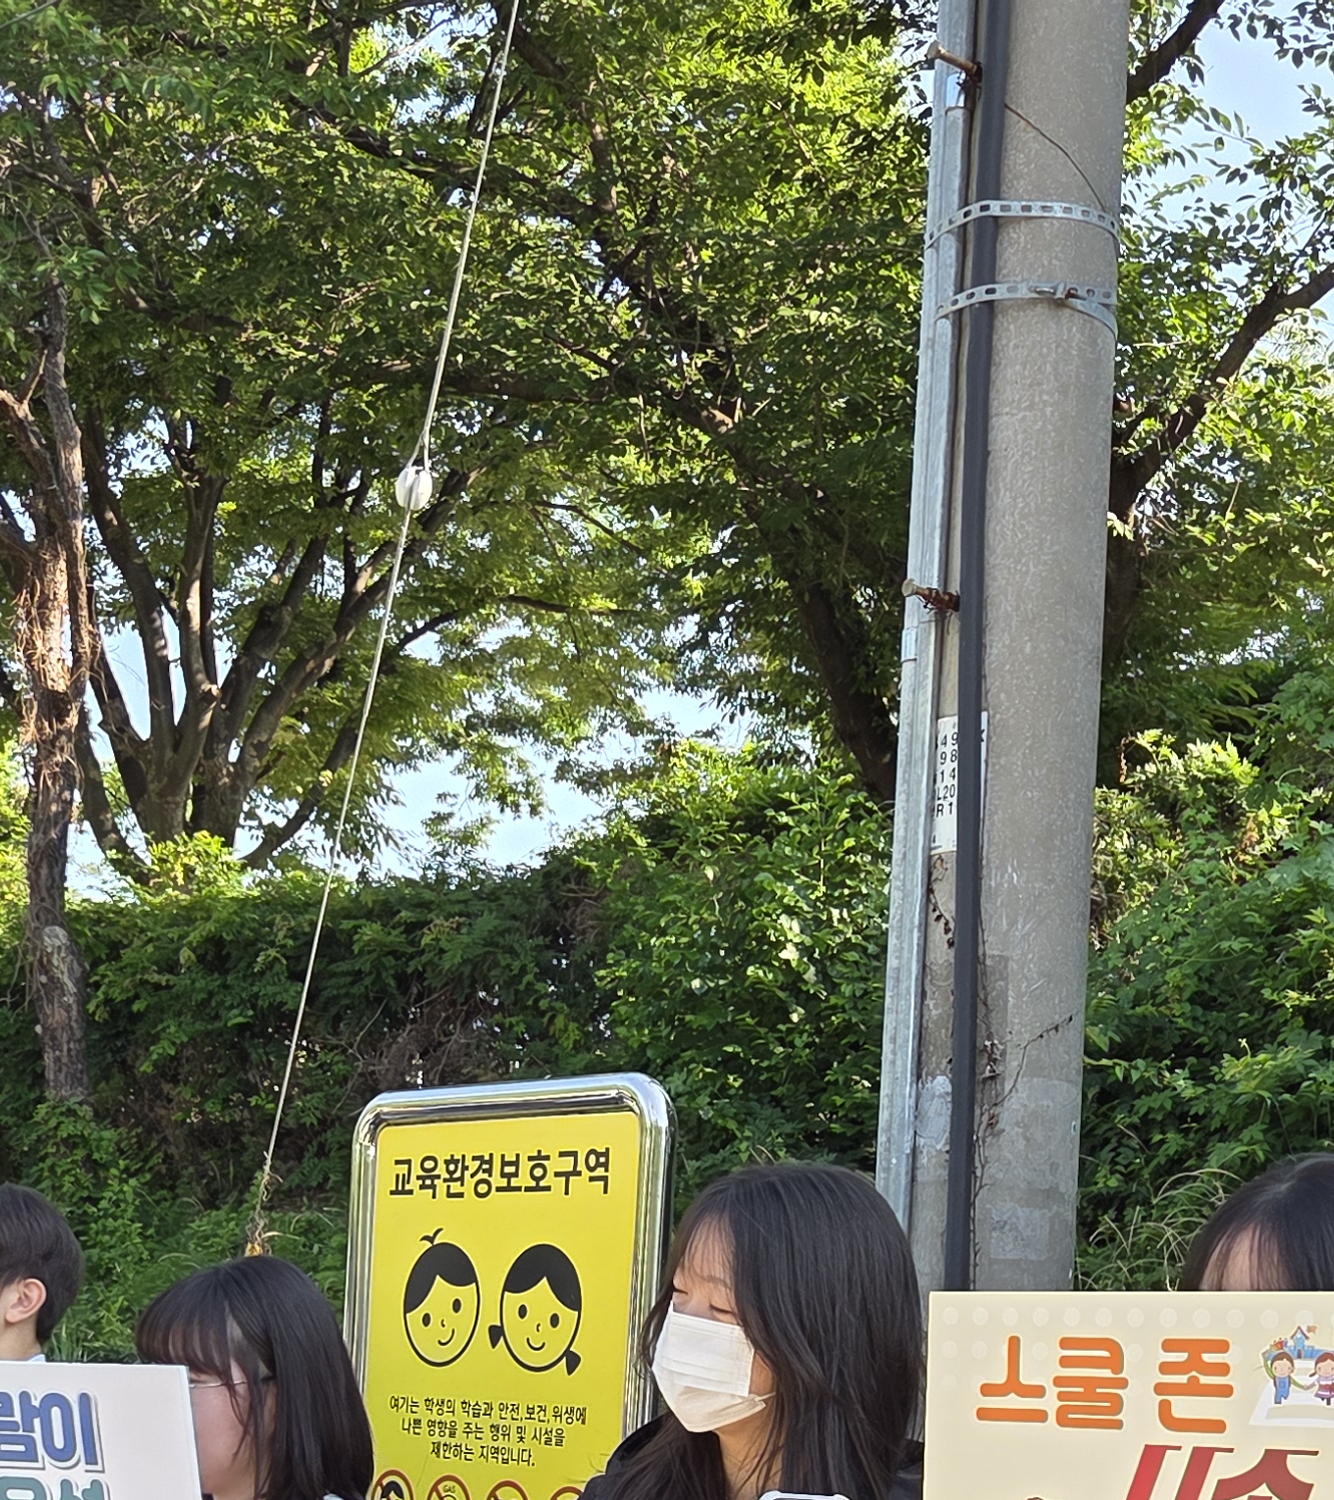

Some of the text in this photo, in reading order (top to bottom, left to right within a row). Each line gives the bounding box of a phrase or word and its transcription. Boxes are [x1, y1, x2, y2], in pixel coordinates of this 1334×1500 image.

[389, 1147, 610, 1199] 교육환경보호구역
[975, 1335, 1236, 1434] 스쿨 존
[389, 1395, 420, 1414] 여기는
[424, 1397, 456, 1416] 학생의
[460, 1399, 494, 1419] 학습과
[402, 1417, 566, 1447] 나쁜 영향을 주는 행위 및 시설을
[430, 1441, 536, 1467] 제한하는 지역입니다.
[443, 1484, 457, 1494] GAS
